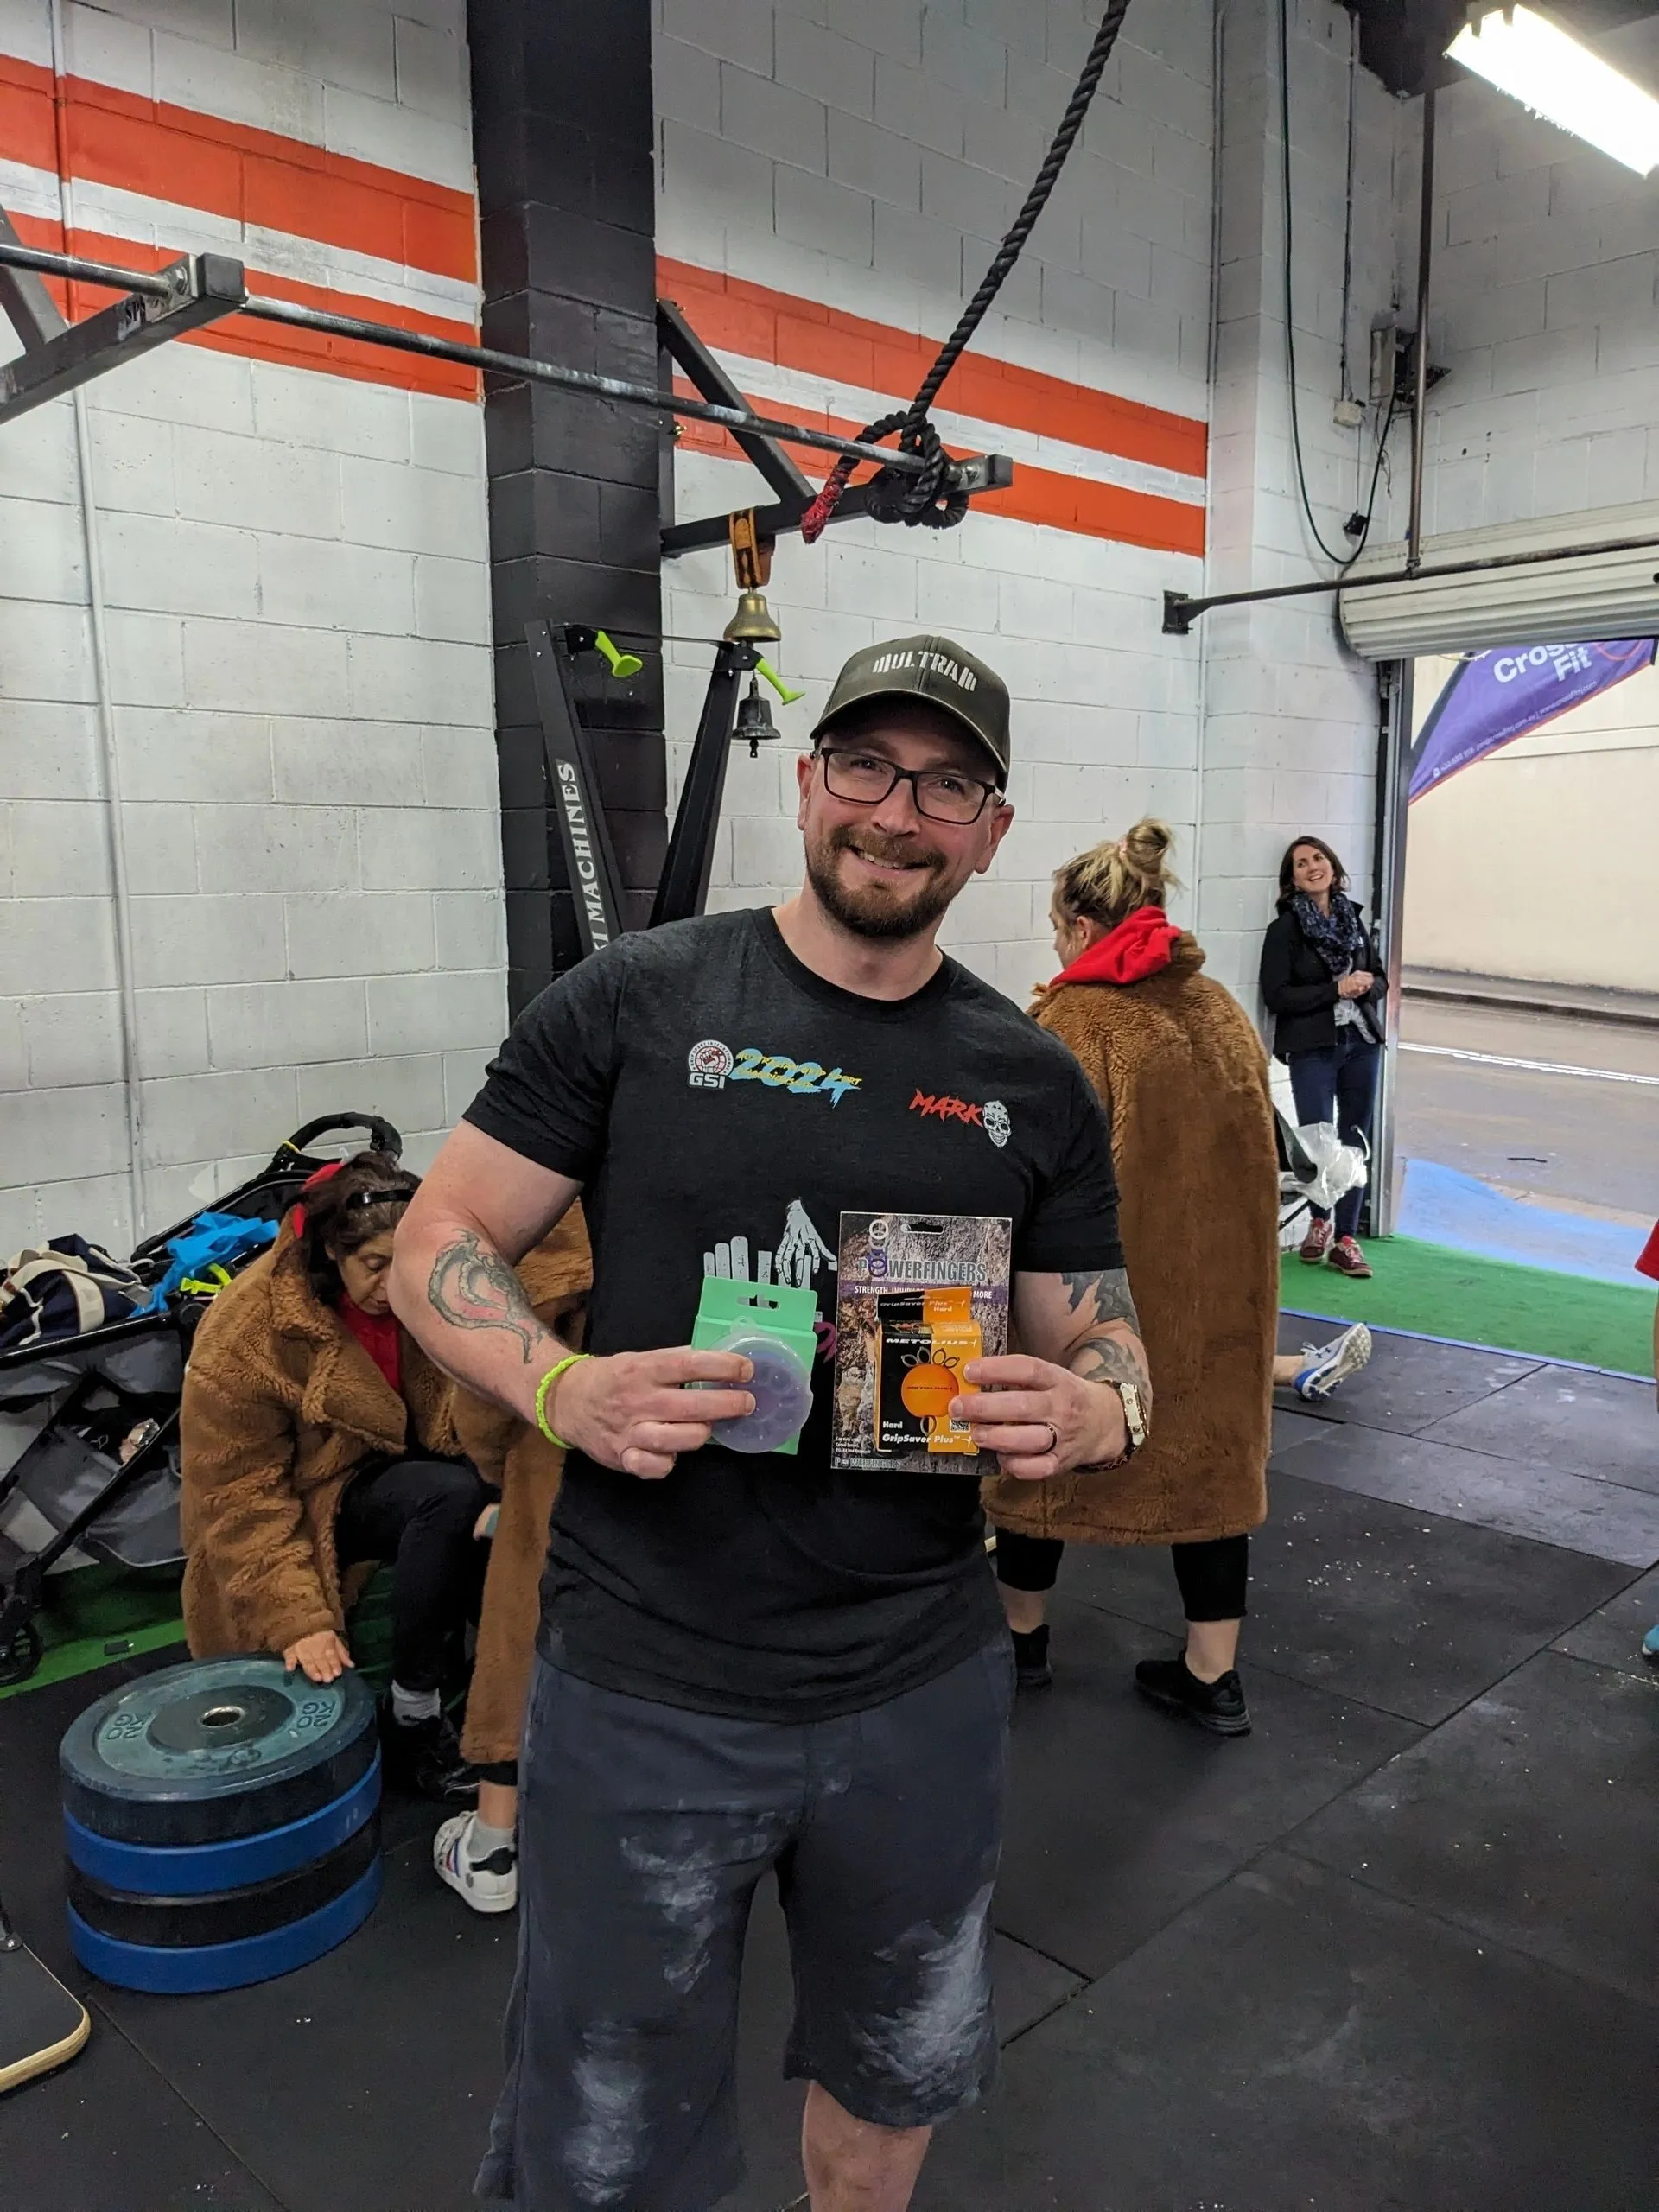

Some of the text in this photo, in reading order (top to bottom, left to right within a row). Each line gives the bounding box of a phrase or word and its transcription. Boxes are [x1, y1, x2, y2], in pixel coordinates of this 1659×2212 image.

[1493, 644, 1579, 683] Cros
[1553, 646, 1592, 682] Fit
[558, 762, 606, 923] MACHINES
[689, 1072, 726, 1089] GSI
[728, 1047, 862, 1109] 2024
[908, 1087, 984, 1128] MARK
[973, 1290, 992, 1299] MORE
[882, 1421, 903, 1429] Hard
[882, 1433, 930, 1444] GripSaver
[296, 1713, 331, 1728] 20
